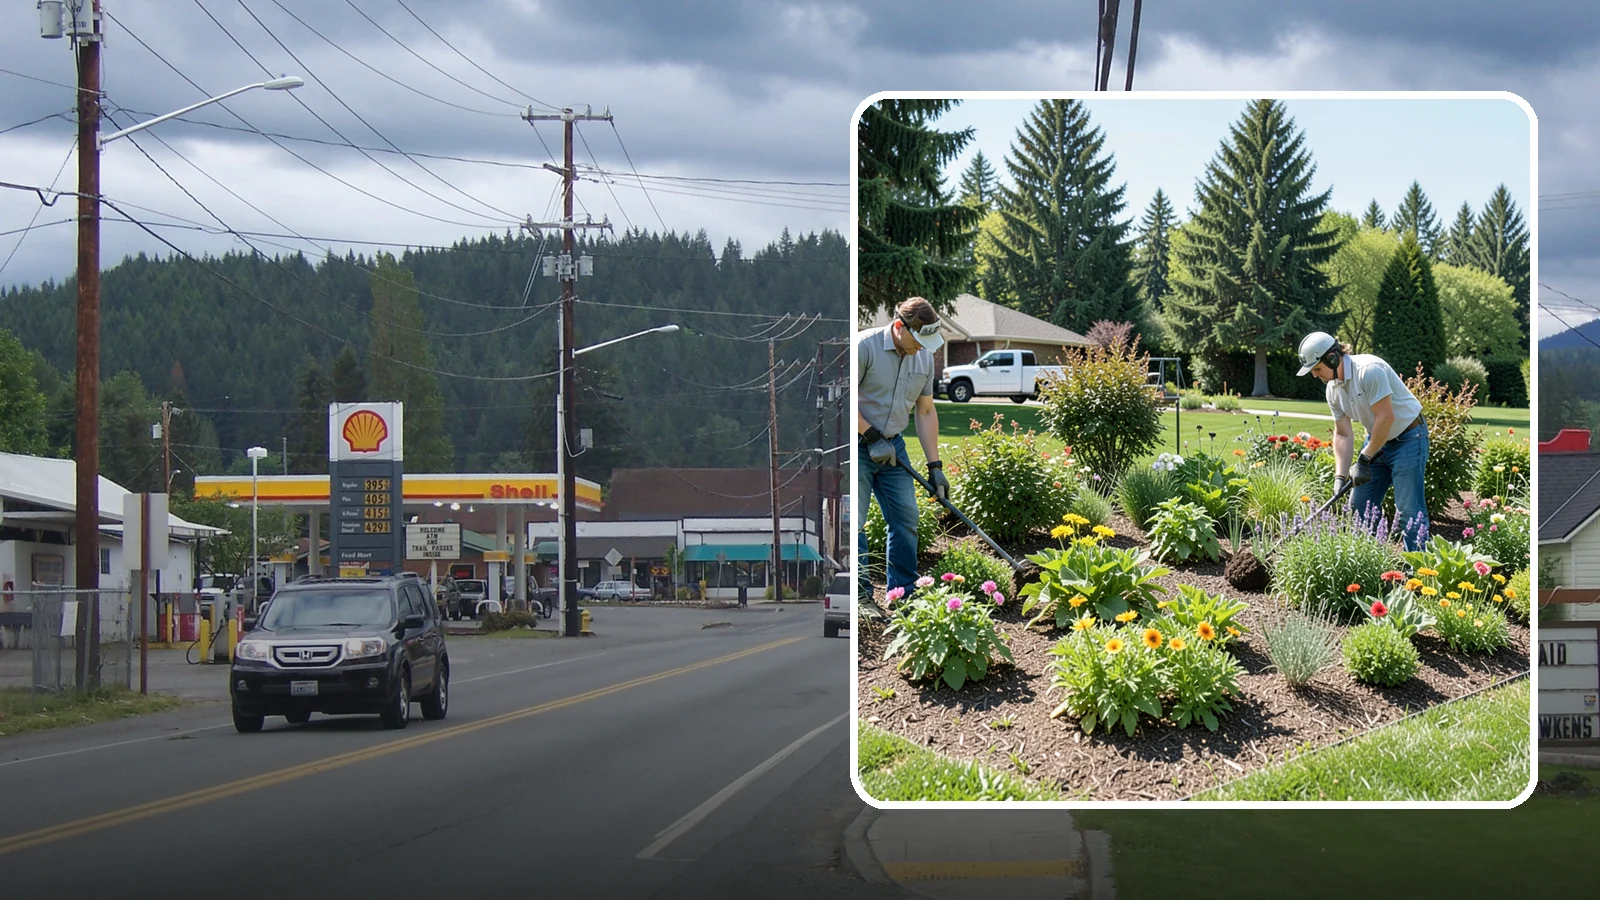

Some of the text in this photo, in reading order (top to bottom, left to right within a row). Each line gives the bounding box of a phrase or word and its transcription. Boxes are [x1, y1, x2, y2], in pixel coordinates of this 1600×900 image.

[366, 480, 383, 490] 395
[490, 484, 547, 499] Shell
[366, 494, 383, 504] 405
[366, 508, 383, 518] 415
[366, 522, 383, 532] 429
